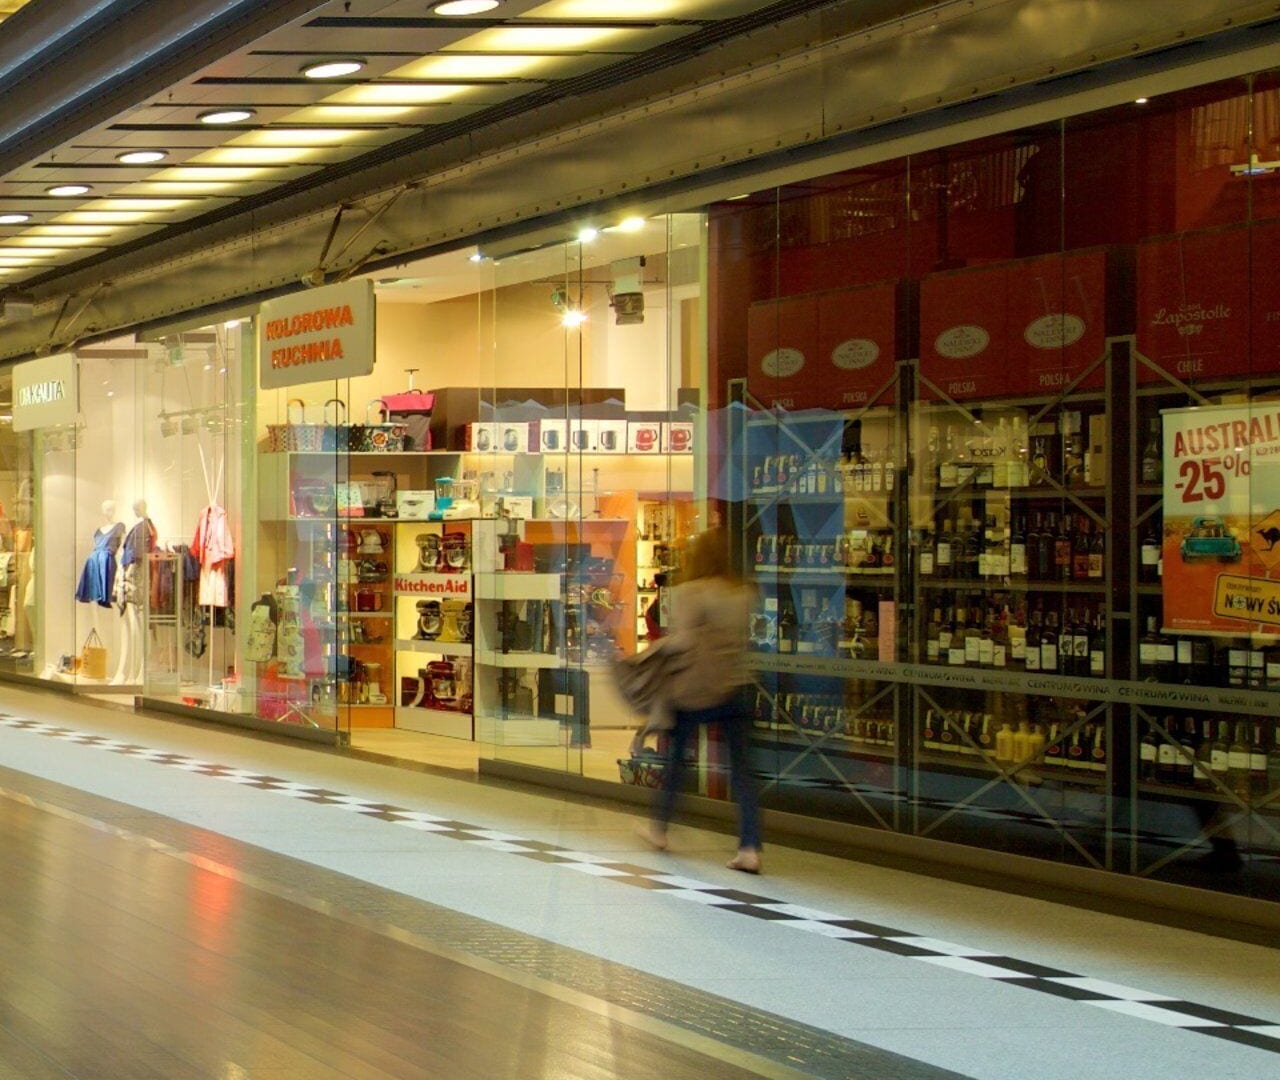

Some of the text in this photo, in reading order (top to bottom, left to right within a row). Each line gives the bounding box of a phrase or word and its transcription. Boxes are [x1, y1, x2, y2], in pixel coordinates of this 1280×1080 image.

[266, 304, 353, 341] KOLOROWA
[271, 338, 344, 369] KUCHNIA
[948, 380, 977, 395] POLSKA
[1175, 454, 1251, 503] -25%
[395, 578, 468, 593] KitchenAid
